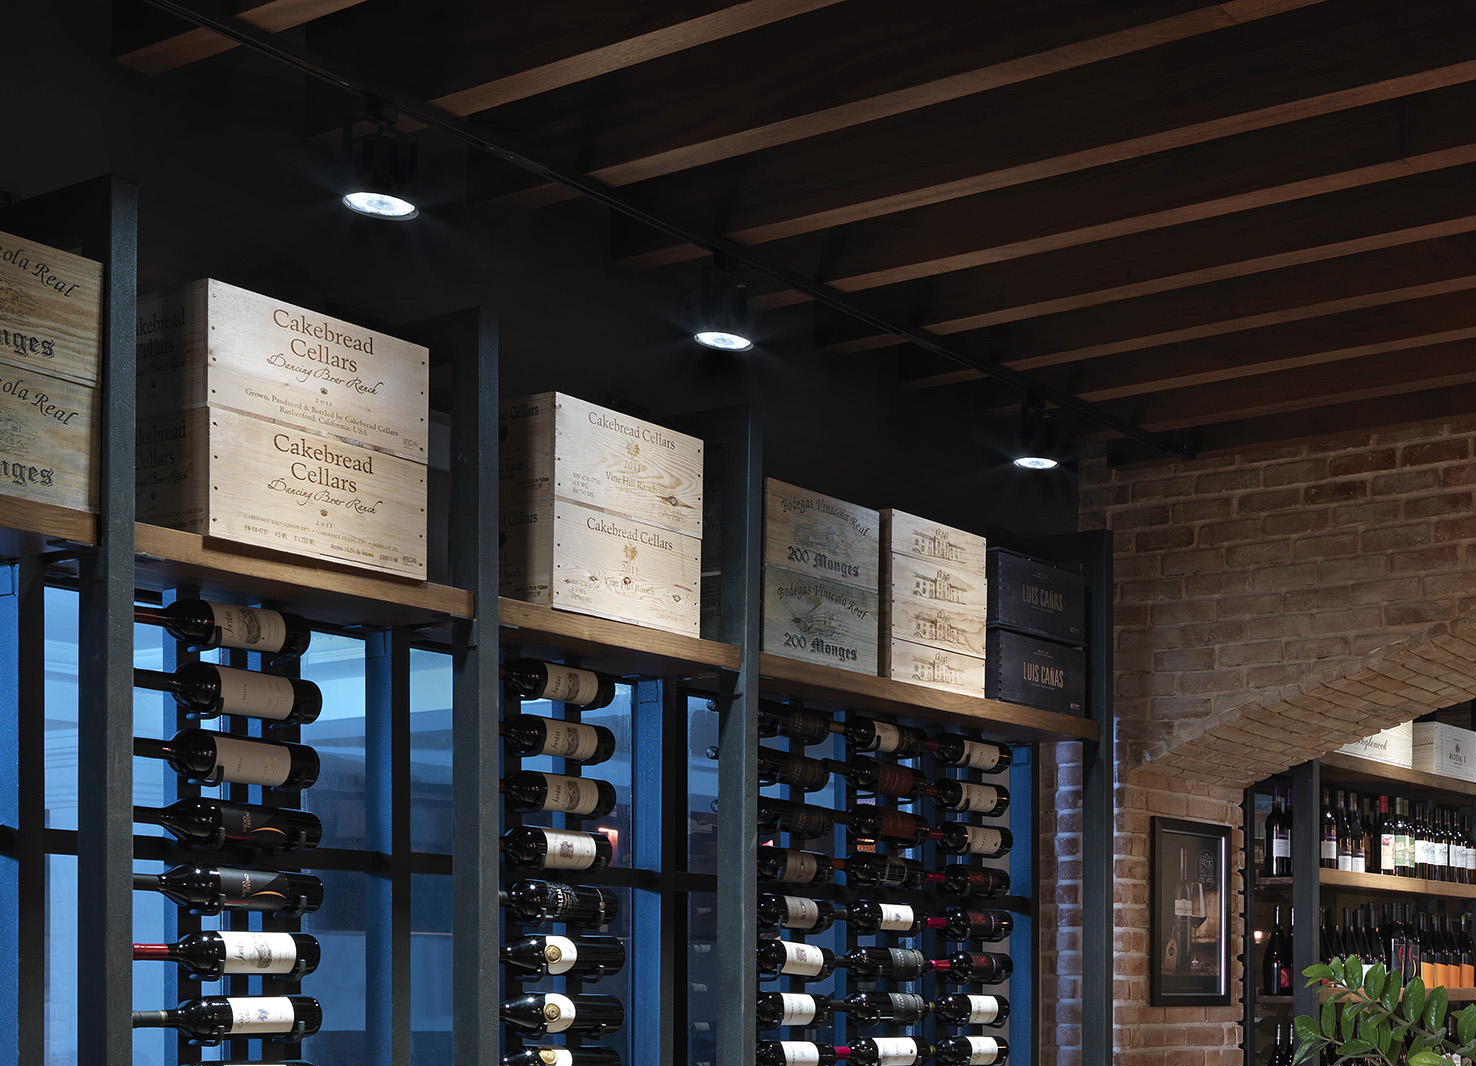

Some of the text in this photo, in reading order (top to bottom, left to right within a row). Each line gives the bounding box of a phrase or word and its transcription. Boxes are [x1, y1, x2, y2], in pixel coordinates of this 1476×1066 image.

[32, 263, 80, 298] Real
[273, 309, 374, 355] Cakebread
[290, 338, 358, 373] Cellars
[266, 353, 384, 395] Dancing Bear Ranch
[31, 392, 79, 426] Real
[271, 395, 303, 411] Produced
[311, 406, 335, 419] Bottled
[344, 415, 377, 431] Cakebread
[352, 426, 368, 436] USA
[588, 411, 676, 450] Cakebread Cellars
[273, 433, 374, 475] Cakebread
[623, 460, 641, 473] 2011
[291, 462, 358, 493] Cellars
[267, 478, 384, 515] Dancing Bear Ranch
[315, 520, 333, 529] 2011
[781, 496, 814, 514] Bodegas
[850, 516, 871, 537] Real
[586, 517, 674, 551] Cakebread Cellars
[621, 563, 640, 575] 2011
[787, 545, 859, 578] 200 Monges
[777, 582, 811, 600] Bodegas
[847, 600, 869, 620] Real
[1022, 583, 1063, 612] LUIS CAÑAS
[784, 632, 857, 662] 200 Monges
[1023, 662, 1064, 688] LUIS CAÑAS
